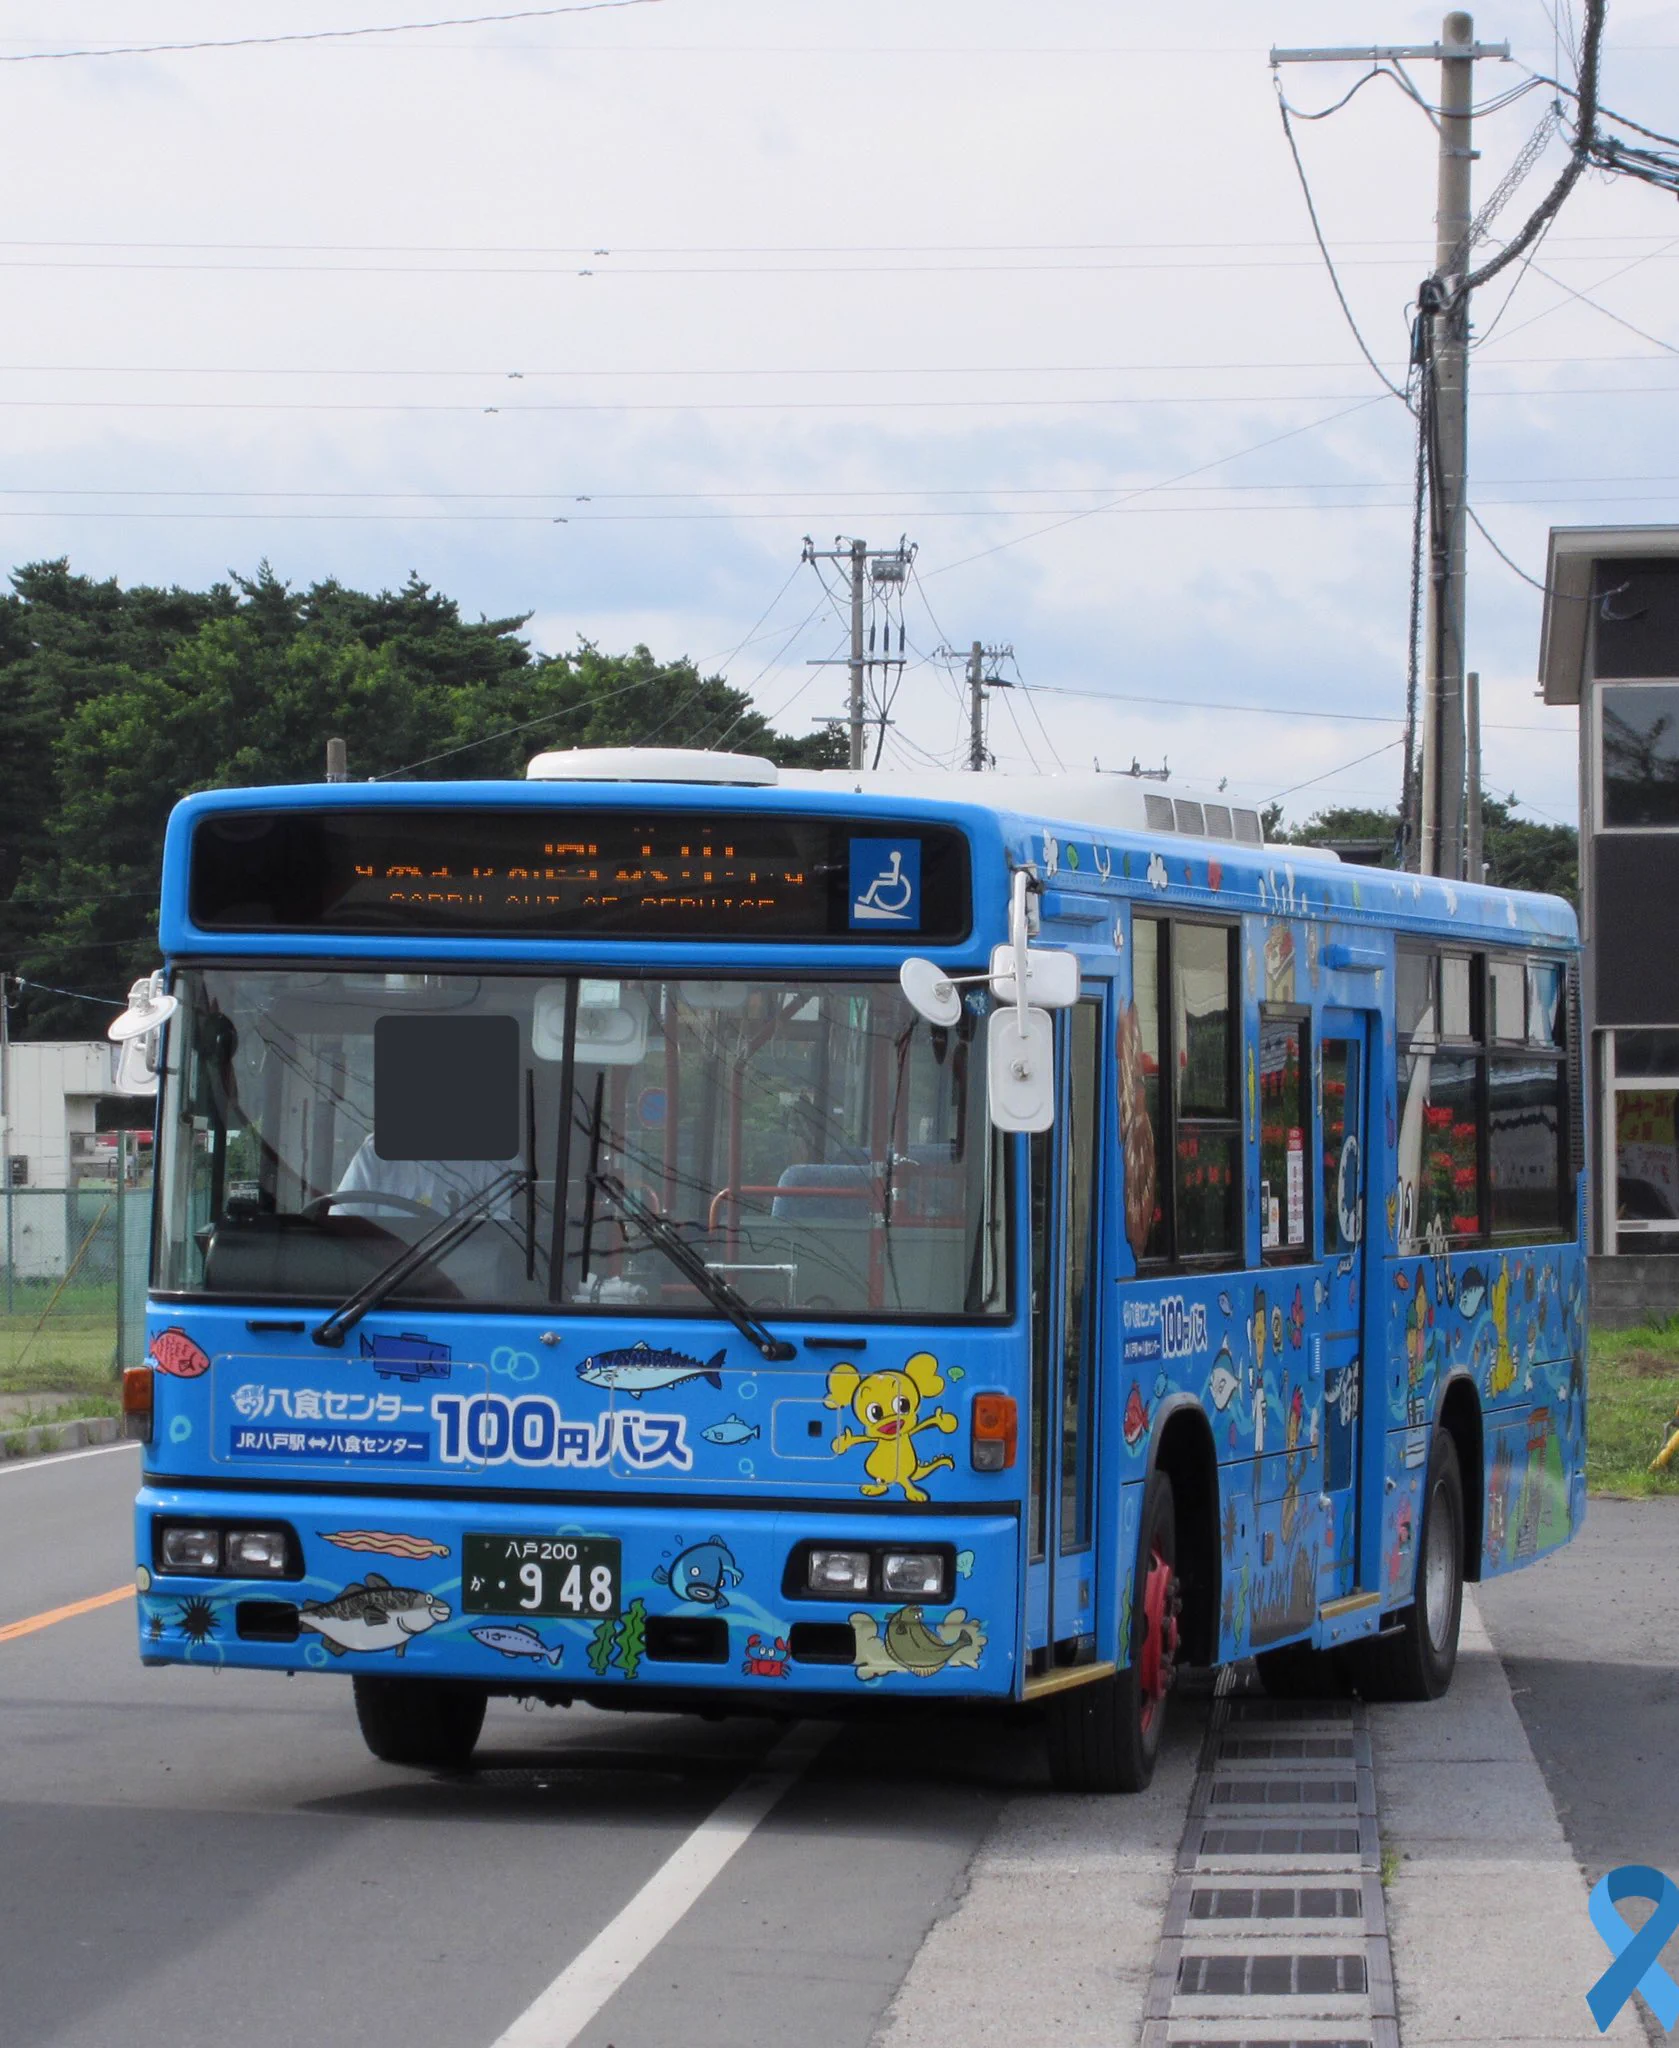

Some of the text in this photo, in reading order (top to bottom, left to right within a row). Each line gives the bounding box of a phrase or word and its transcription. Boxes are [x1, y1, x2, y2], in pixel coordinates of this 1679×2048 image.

[264, 1388, 425, 1422] 八食センター
[431, 1393, 693, 1471] 100円バス
[505, 1541, 578, 1560] 八戸200
